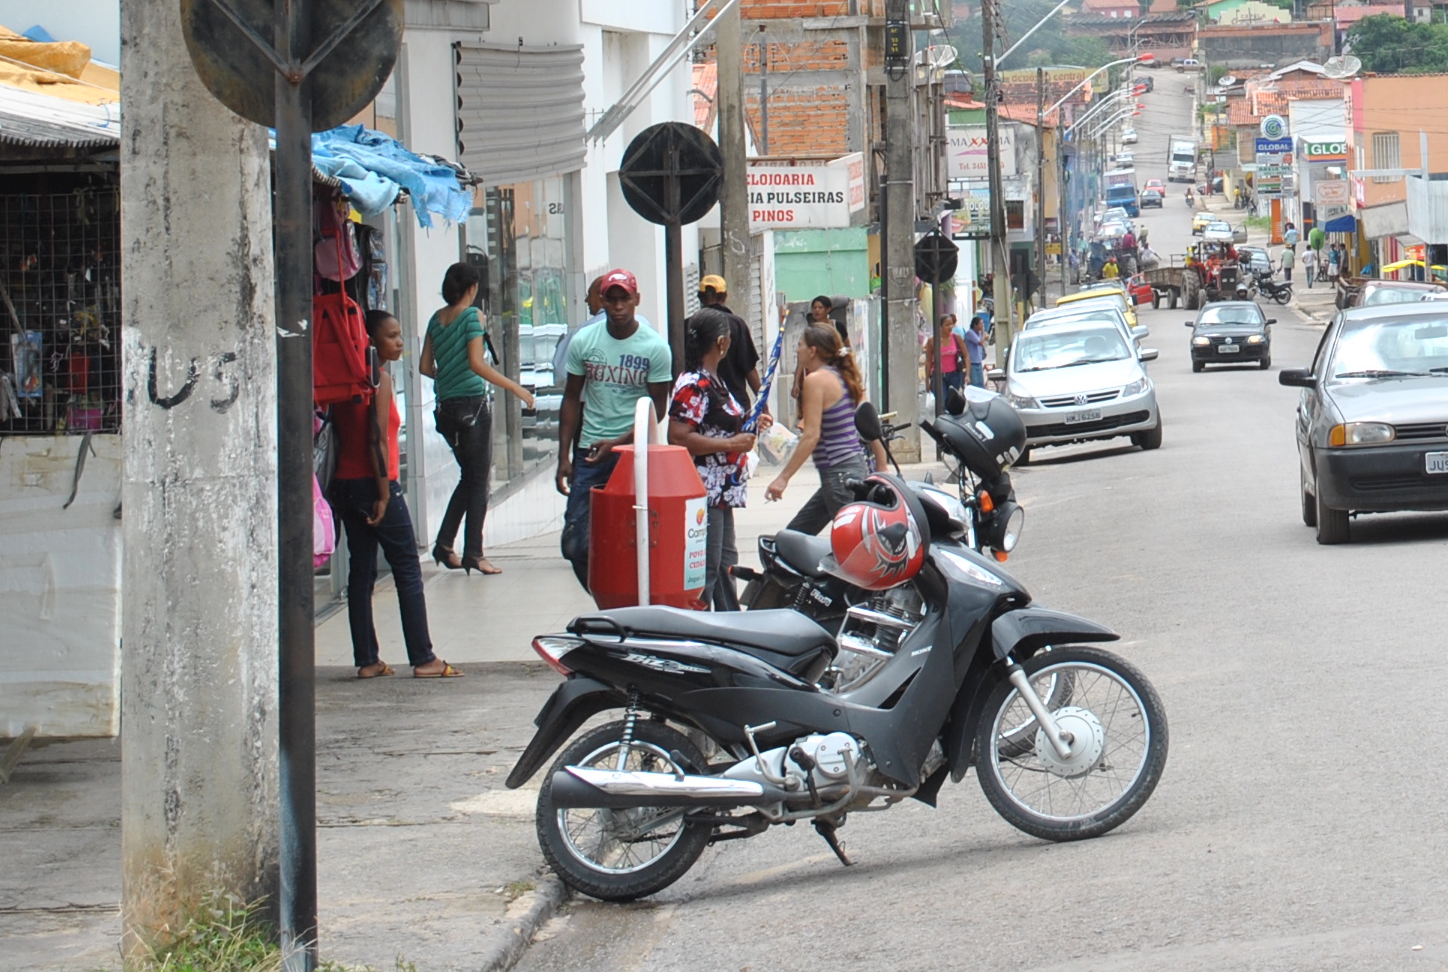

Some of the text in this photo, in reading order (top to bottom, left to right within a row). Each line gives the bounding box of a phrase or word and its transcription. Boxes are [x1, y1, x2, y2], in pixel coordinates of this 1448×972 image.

[767, 192, 844, 204] PULSEIRAS
[753, 210, 794, 222] PINOS
[620, 354, 650, 371] 1899
